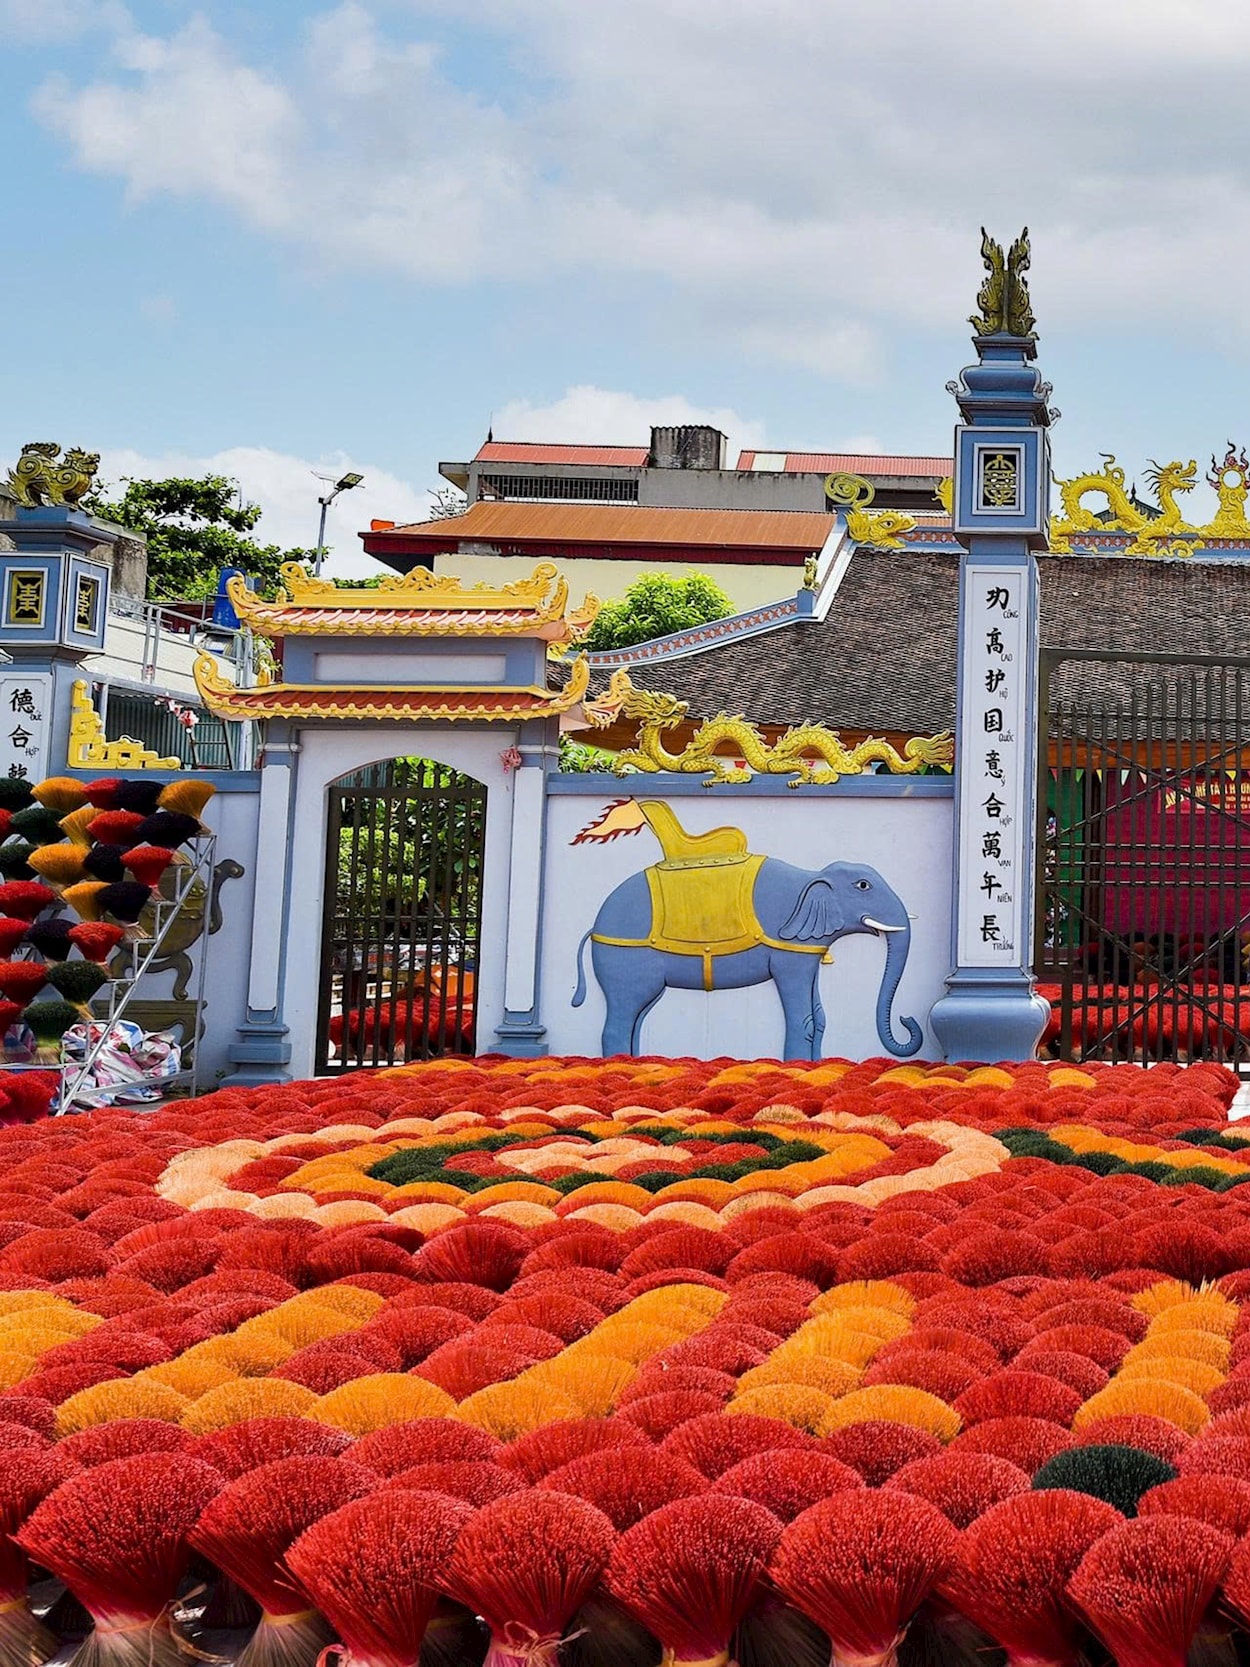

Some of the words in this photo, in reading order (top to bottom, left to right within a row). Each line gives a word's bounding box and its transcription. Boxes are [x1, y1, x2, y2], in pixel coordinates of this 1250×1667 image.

[1003, 609, 1019, 619] CÔNG
[1001, 654, 1013, 662] CAO
[997, 892, 1012, 903] NIÊN
